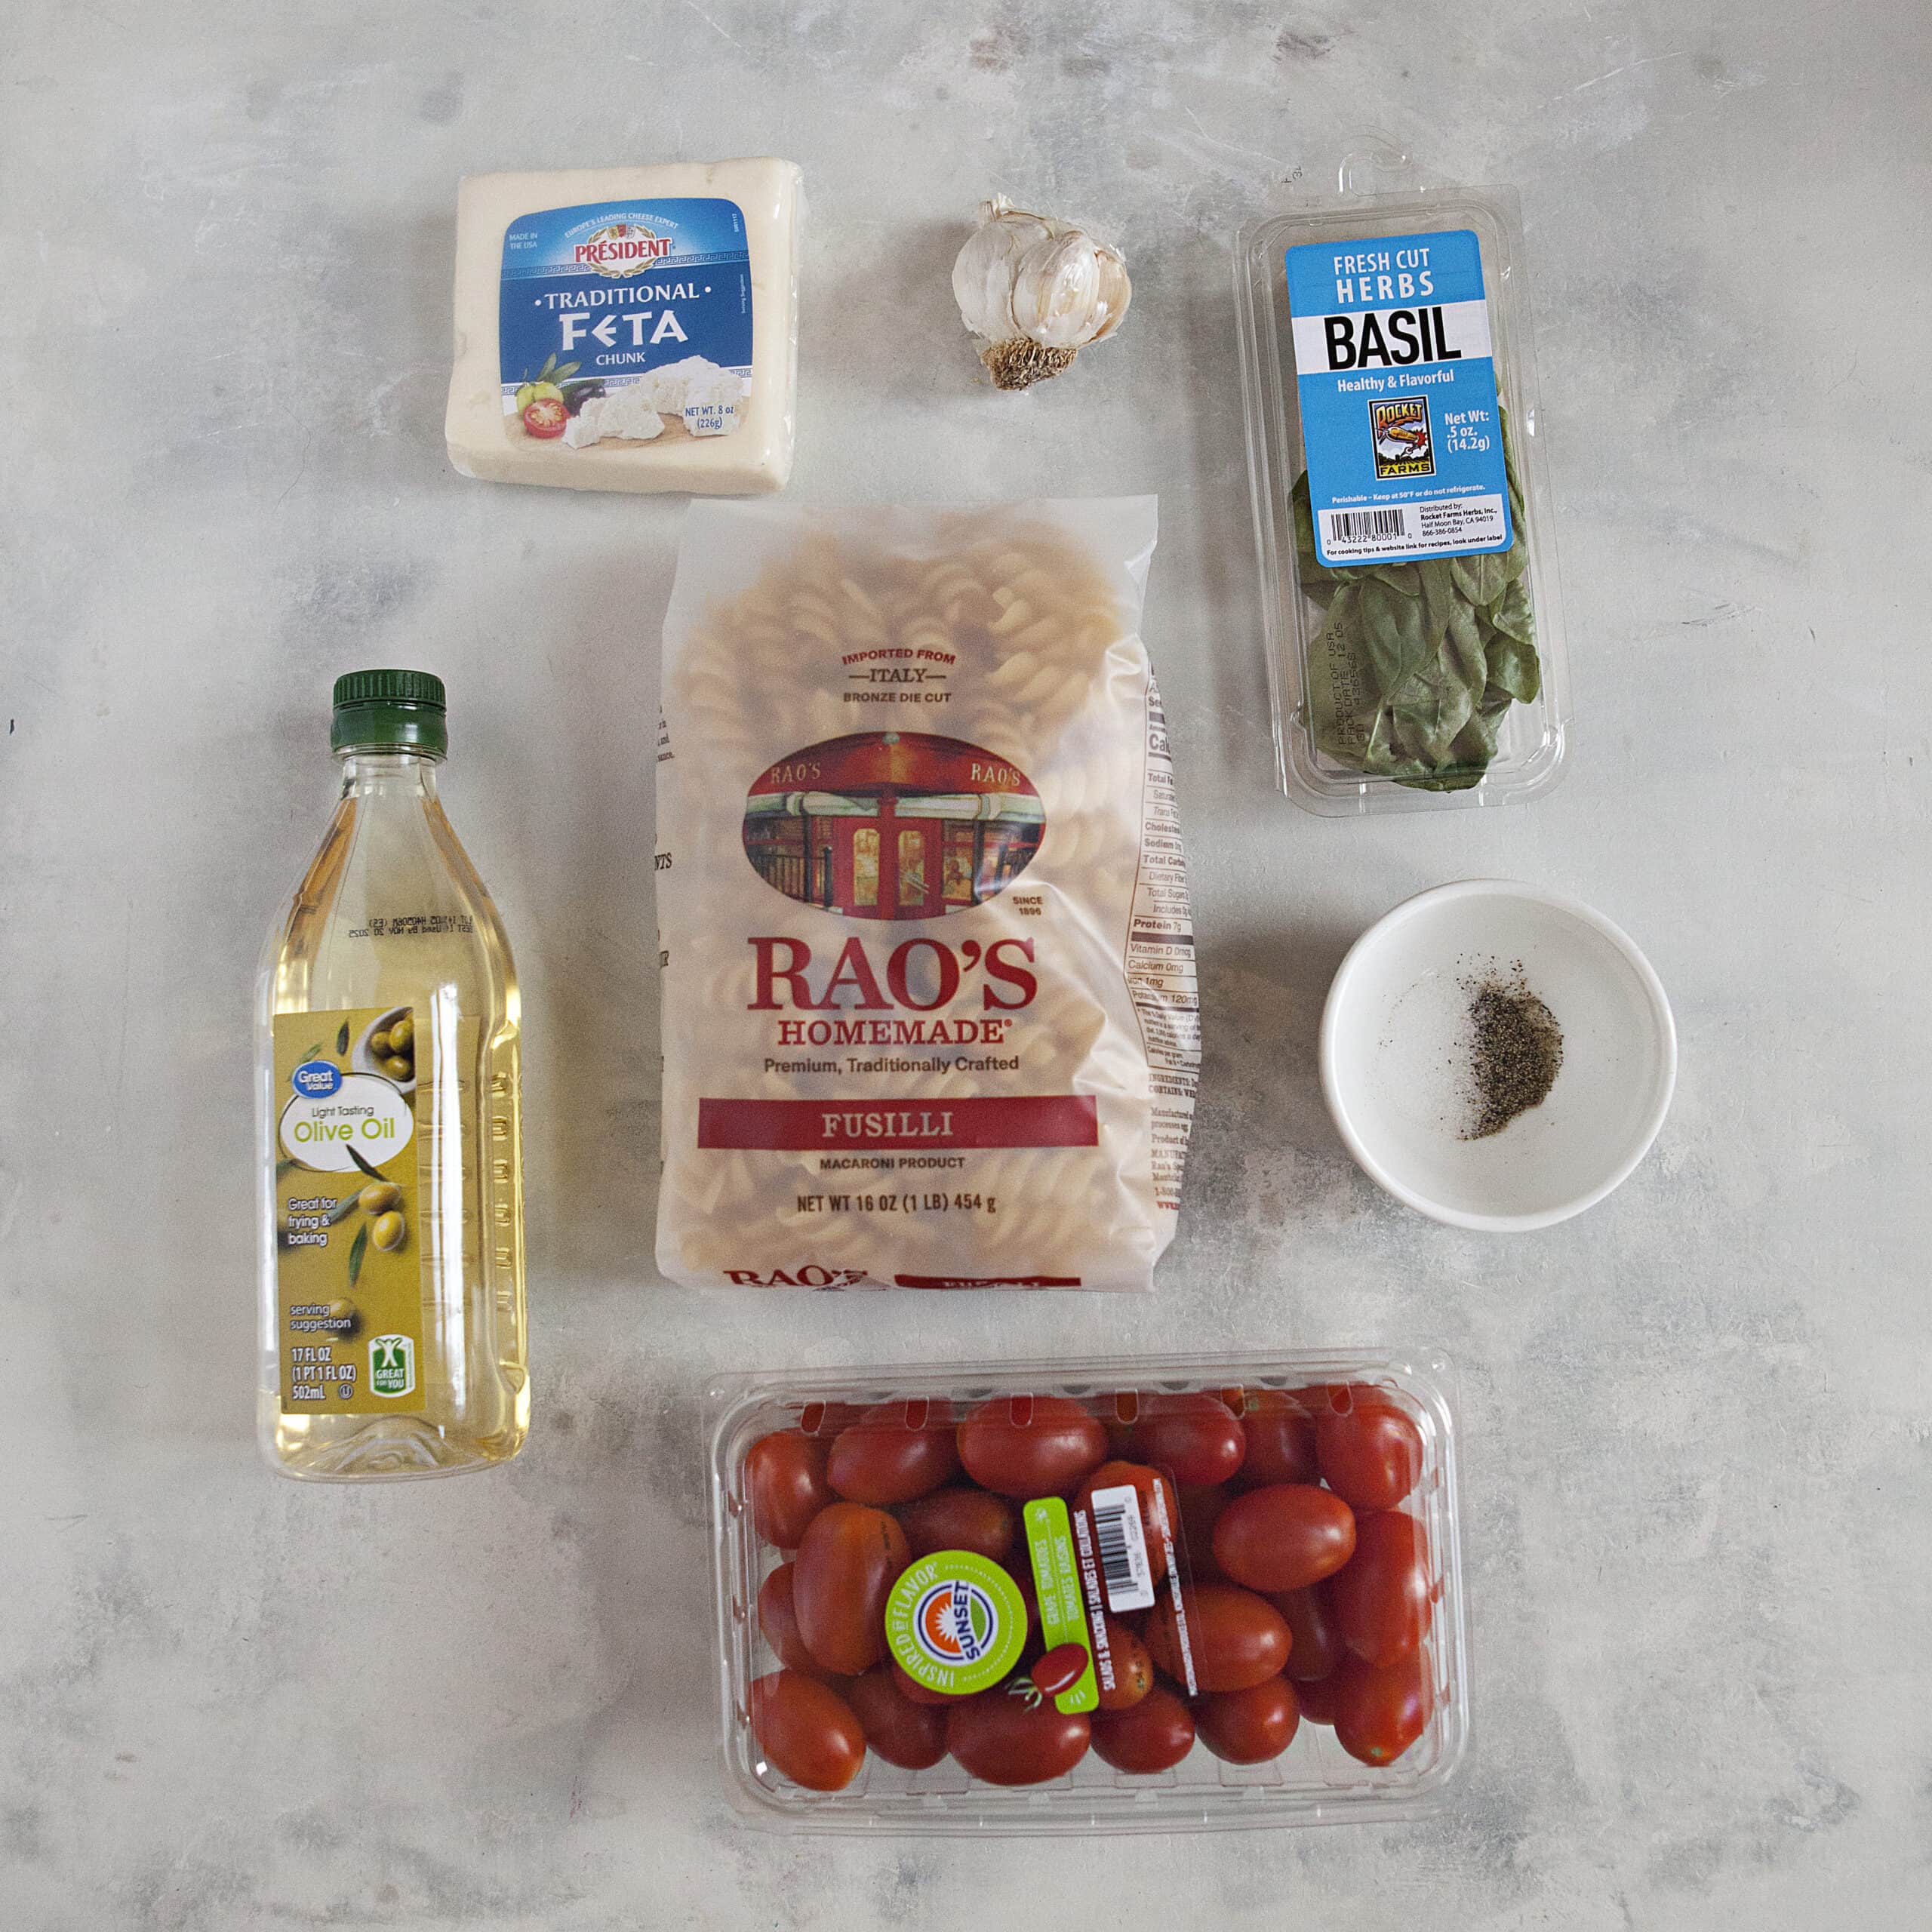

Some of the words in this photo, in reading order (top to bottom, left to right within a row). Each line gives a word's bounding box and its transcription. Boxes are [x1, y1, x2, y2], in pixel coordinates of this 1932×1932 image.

[597, 213, 626, 223] LEADING
[628, 212, 654, 220] CHEESE
[654, 216, 678, 229] EXPERT
[575, 238, 671, 264] PRÉSIDENT
[1334, 252, 1391, 275] FRESH
[1396, 248, 1430, 269] CUT
[1336, 270, 1434, 304] HERBS
[544, 282, 700, 309] TRADITIONAL
[558, 309, 689, 351] FETA
[1324, 306, 1462, 371] BASIL
[595, 352, 646, 366] CHUNK
[1337, 377, 1386, 393] Healthy
[1388, 376, 1397, 388] &
[1400, 368, 1454, 387] Flavorful
[685, 406, 700, 417] NET
[702, 405, 716, 415] WT.
[718, 405, 723, 414] 8
[725, 406, 734, 414] oz
[1376, 402, 1423, 428] ROCKET
[1444, 412, 1466, 426] Net
[1467, 410, 1490, 423] Wt:
[697, 416, 723, 430] (226g)
[1447, 427, 1457, 438] .5
[1460, 426, 1478, 438] oz.
[1447, 436, 1491, 453] (14.2g)
[1380, 463, 1431, 475] FARMS
[1332, 495, 1367, 504] Perishable
[1373, 494, 1390, 502] Keep
[1399, 490, 1415, 498] 50°F
[1423, 488, 1432, 497] do
[1447, 484, 1486, 495] refrigerate.
[1420, 503, 1453, 513] Distributed
[1420, 512, 1442, 521] Rocket
[1463, 508, 1484, 516] Herbs,
[1421, 521, 1433, 529] Half
[1434, 519, 1452, 528] Moon
[1341, 534, 1368, 545] 43222
[1371, 533, 1398, 543] 80001
[1422, 527, 1463, 537] 866-386-0854
[1327, 549, 1337, 557] For
[1338, 547, 1362, 556] cooking
[1363, 546, 1375, 554] tips
[1381, 543, 1405, 552] website
[1428, 540, 1452, 549] recipes,
[1487, 534, 1503, 542] label
[1334, 622, 1343, 638] 05
[1326, 632, 1337, 657] USA
[1338, 644, 1346, 658] 12
[841, 648, 913, 666] IMPORTED
[916, 648, 956, 666] FROM
[869, 668, 928, 683] ITALY
[1330, 663, 1340, 680] OF
[1340, 671, 1352, 707] DATE
[843, 692, 896, 703] BRONZE
[900, 692, 921, 703] DIE
[925, 692, 952, 703] CUT
[1333, 683, 1347, 745] PRODUCT
[1345, 711, 1356, 745] PACK
[770, 761, 822, 784] RAO'S
[971, 762, 1021, 786] RAO'S
[1147, 772, 1166, 783] Total
[1143, 854, 1166, 865] Total
[1149, 871, 1174, 884] Dietary
[1147, 887, 1166, 897] Total
[1013, 896, 1043, 906] SINCE
[1019, 907, 1041, 915] 1896
[1153, 904, 1182, 915] Includes
[1134, 918, 1172, 930] Protein
[1173, 921, 1182, 933] 7g
[1131, 943, 1164, 955] Vitamin
[1165, 946, 1173, 955] D
[1128, 959, 1164, 971] Calcium
[1166, 962, 1184, 974] 0mg
[746, 936, 1038, 1013] RAO'S
[1146, 977, 1164, 989] 1mg
[1171, 995, 1198, 1007] 120mg
[778, 1018, 1004, 1046] HOMEMADE
[764, 1058, 842, 1075] Premium,
[848, 1057, 951, 1075] Traditionally
[955, 1056, 1020, 1072] Crafted
[299, 1069, 334, 1084] Great
[307, 1082, 334, 1091] Value
[312, 1106, 335, 1118] Light
[338, 1105, 374, 1117] Tasting
[294, 1120, 353, 1143] Olive
[361, 1117, 395, 1140] Oil
[822, 1111, 954, 1137] FUSILLI
[1152, 1134, 1179, 1144] Product
[820, 1158, 894, 1169] MACARONI
[899, 1157, 965, 1169] PRODUCT
[288, 1197, 319, 1211] Great
[321, 1196, 337, 1210] for
[797, 1195, 823, 1212] NET
[829, 1195, 851, 1212] WT
[857, 1195, 873, 1211] 16
[879, 1195, 897, 1211] OZ
[903, 1193, 917, 1214] (1
[924, 1193, 949, 1212] LB)
[955, 1194, 982, 1211] 454
[987, 1197, 996, 1213] g
[289, 1214, 319, 1229] frying
[321, 1214, 331, 1226] &
[289, 1232, 328, 1247] baking
[291, 1304, 330, 1317] serving
[291, 1318, 352, 1332] suggestion
[291, 1348, 303, 1362] 17
[306, 1347, 316, 1361] FL
[318, 1346, 332, 1361] OZ
[292, 1365, 301, 1383] (1
[303, 1366, 315, 1380] PT
[318, 1366, 323, 1380] 1
[326, 1365, 337, 1380] FL
[340, 1364, 357, 1383] OZ)
[377, 1368, 405, 1379] GREAT
[388, 1379, 405, 1389] YOU
[292, 1385, 326, 1400] 502mL
[1073, 1509, 1094, 1558] COLLATIONS
[1081, 1558, 1096, 1570] ET
[894, 1562, 937, 1617] FLAVOR
[1084, 1569, 1102, 1605] SALADES
[1062, 1576, 1080, 1622] TOMATES
[954, 1580, 981, 1660] SUNSET
[1091, 1611, 1109, 1651] SNACKING
[896, 1634, 955, 1688] INSPIRED
[1099, 1660, 1117, 1691] SALADS
